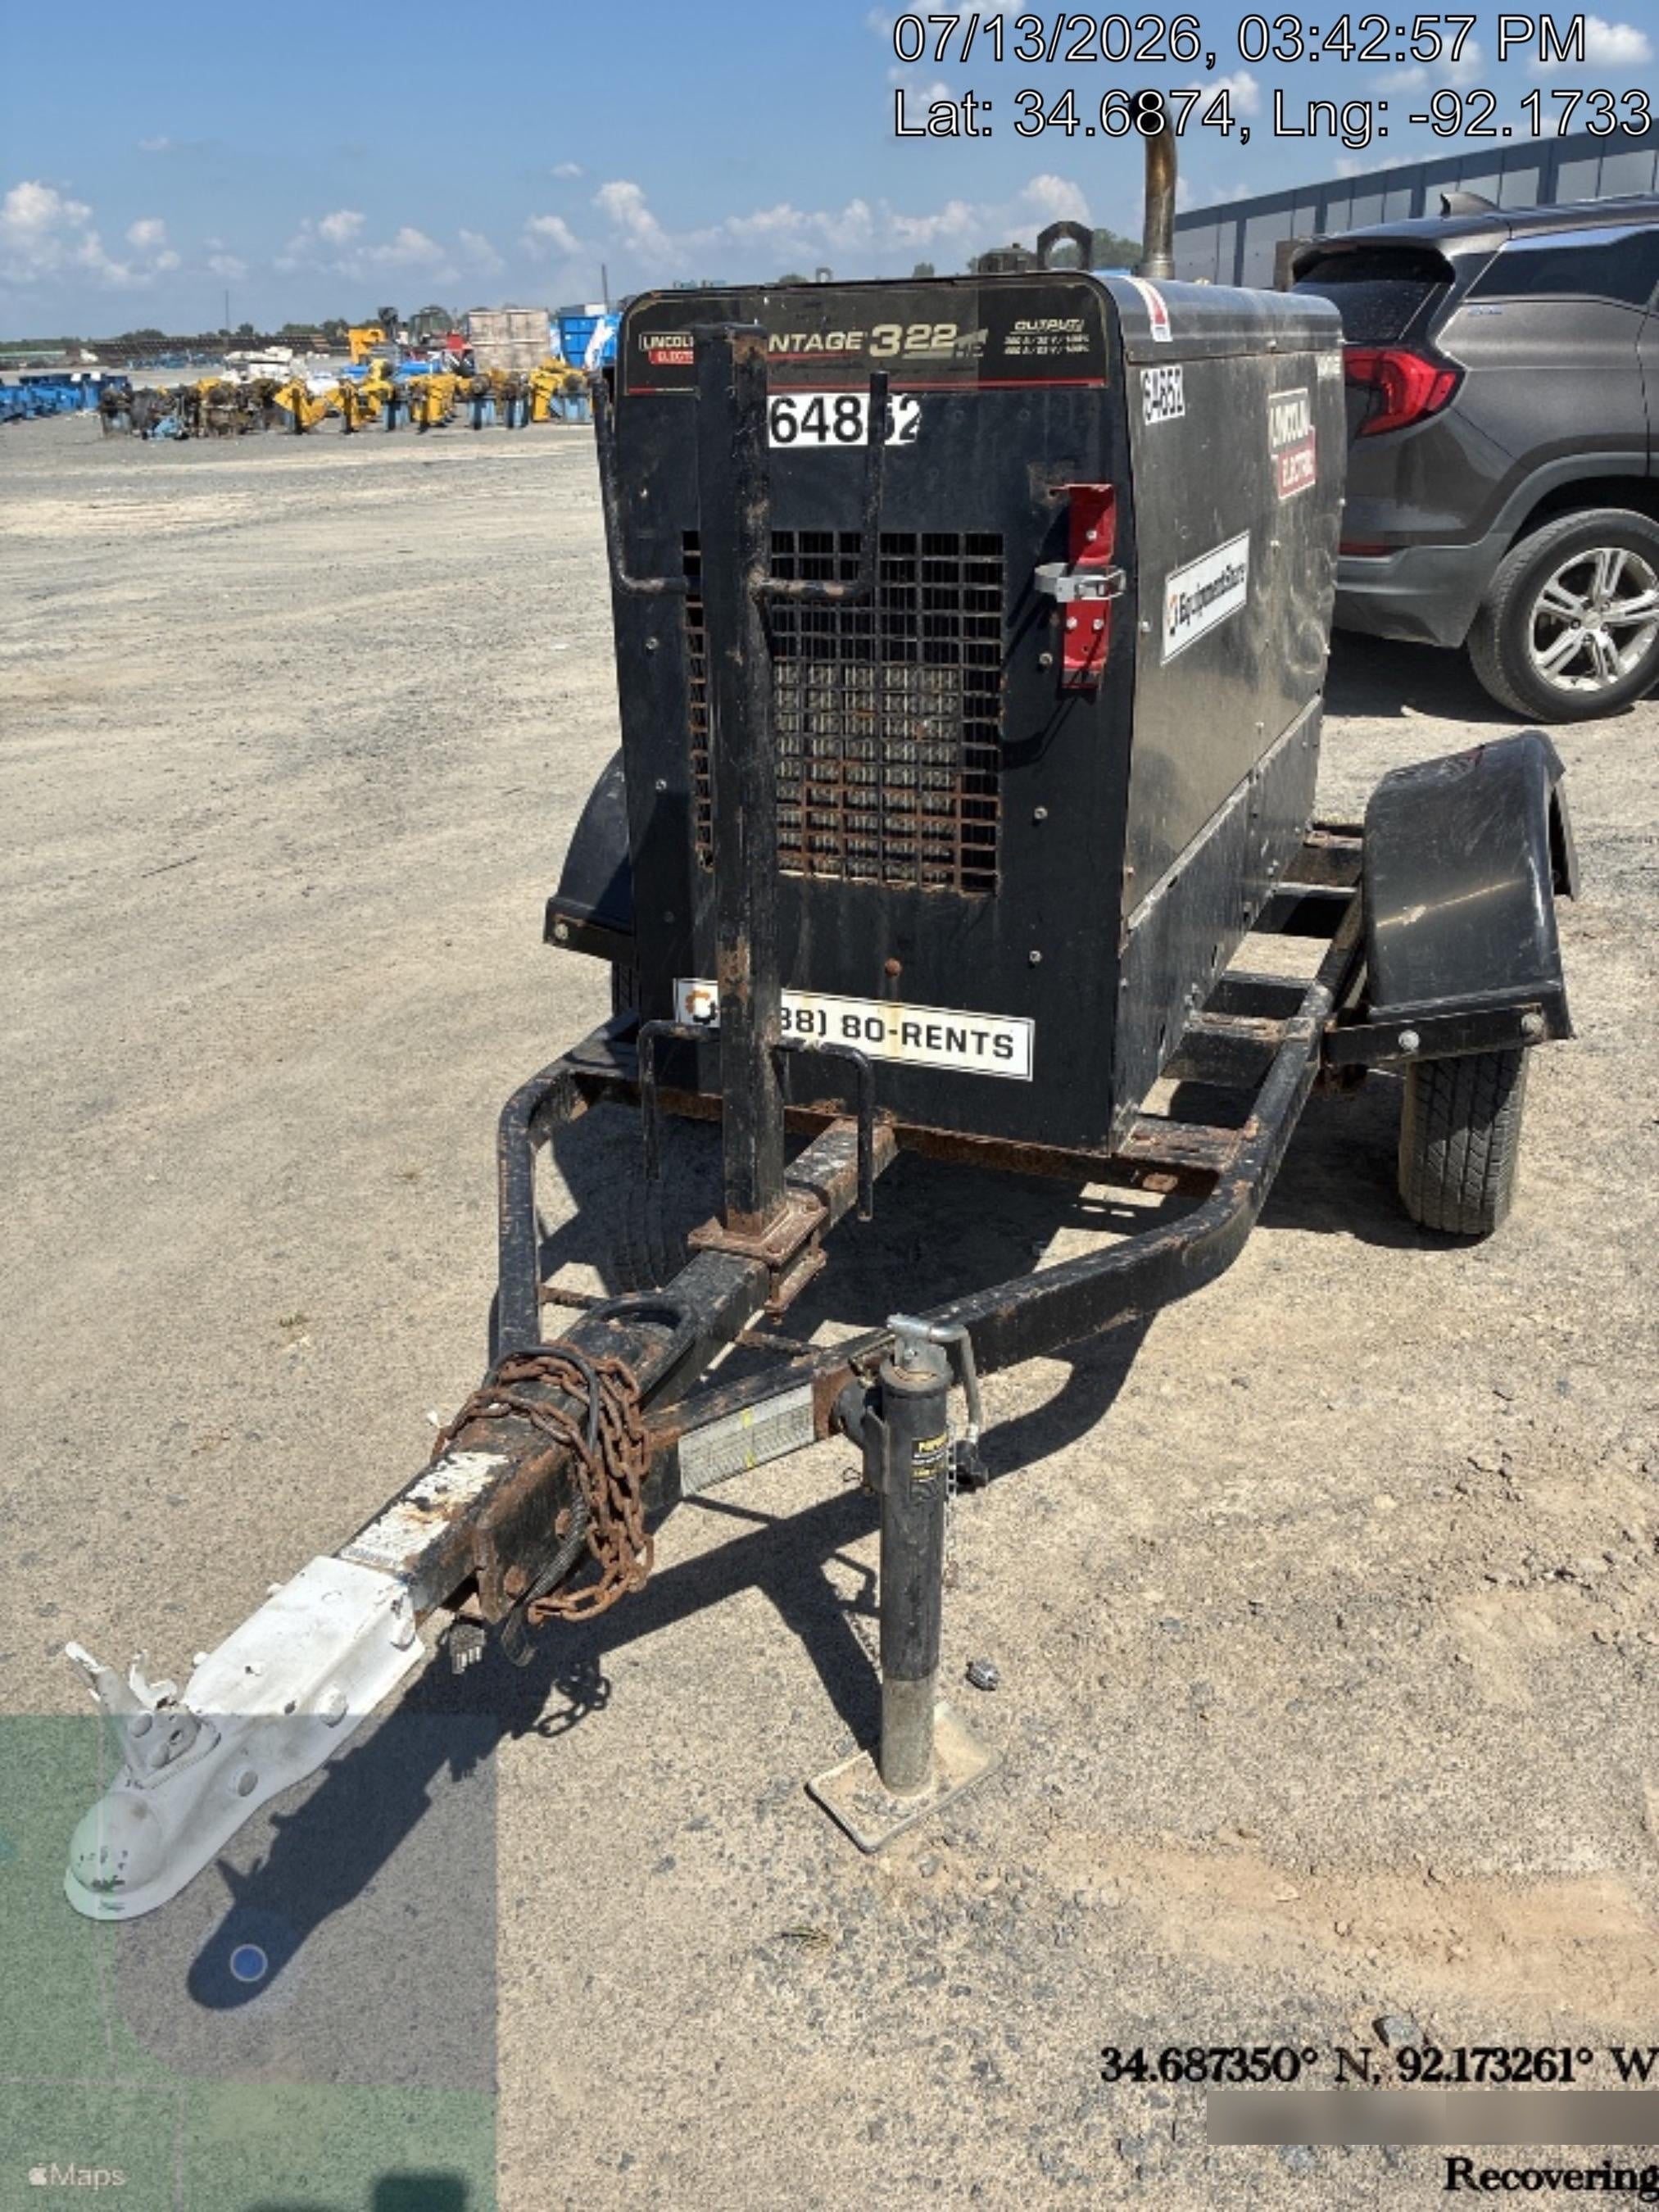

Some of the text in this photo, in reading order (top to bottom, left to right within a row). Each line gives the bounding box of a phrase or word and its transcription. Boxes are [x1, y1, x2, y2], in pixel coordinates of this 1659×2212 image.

[768, 331, 863, 353] NTAGE
[868, 324, 958, 358] 322
[841, 1014, 1014, 1060] 80-RENTS
